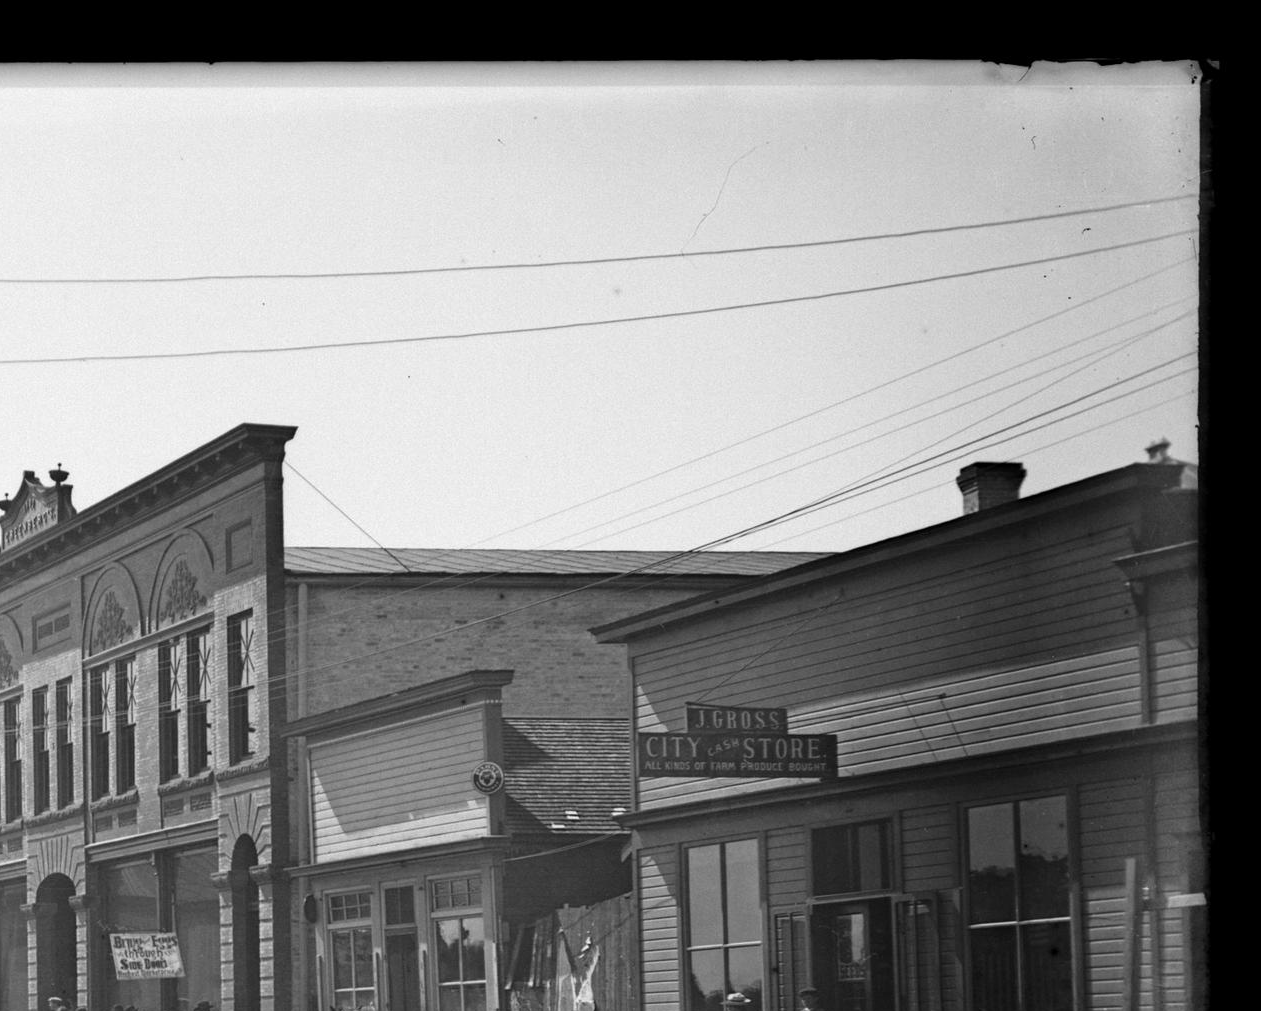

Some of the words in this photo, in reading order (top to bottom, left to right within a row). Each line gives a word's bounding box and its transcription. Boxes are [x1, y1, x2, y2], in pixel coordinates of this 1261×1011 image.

[646, 736, 701, 758] CITY
[707, 738, 739, 759] CASH
[743, 737, 827, 759] STORE.
[643, 761, 662, 770] ALL
[665, 761, 690, 770] KINDS
[710, 762, 736, 771] FARM
[740, 762, 784, 772] PRODUCE
